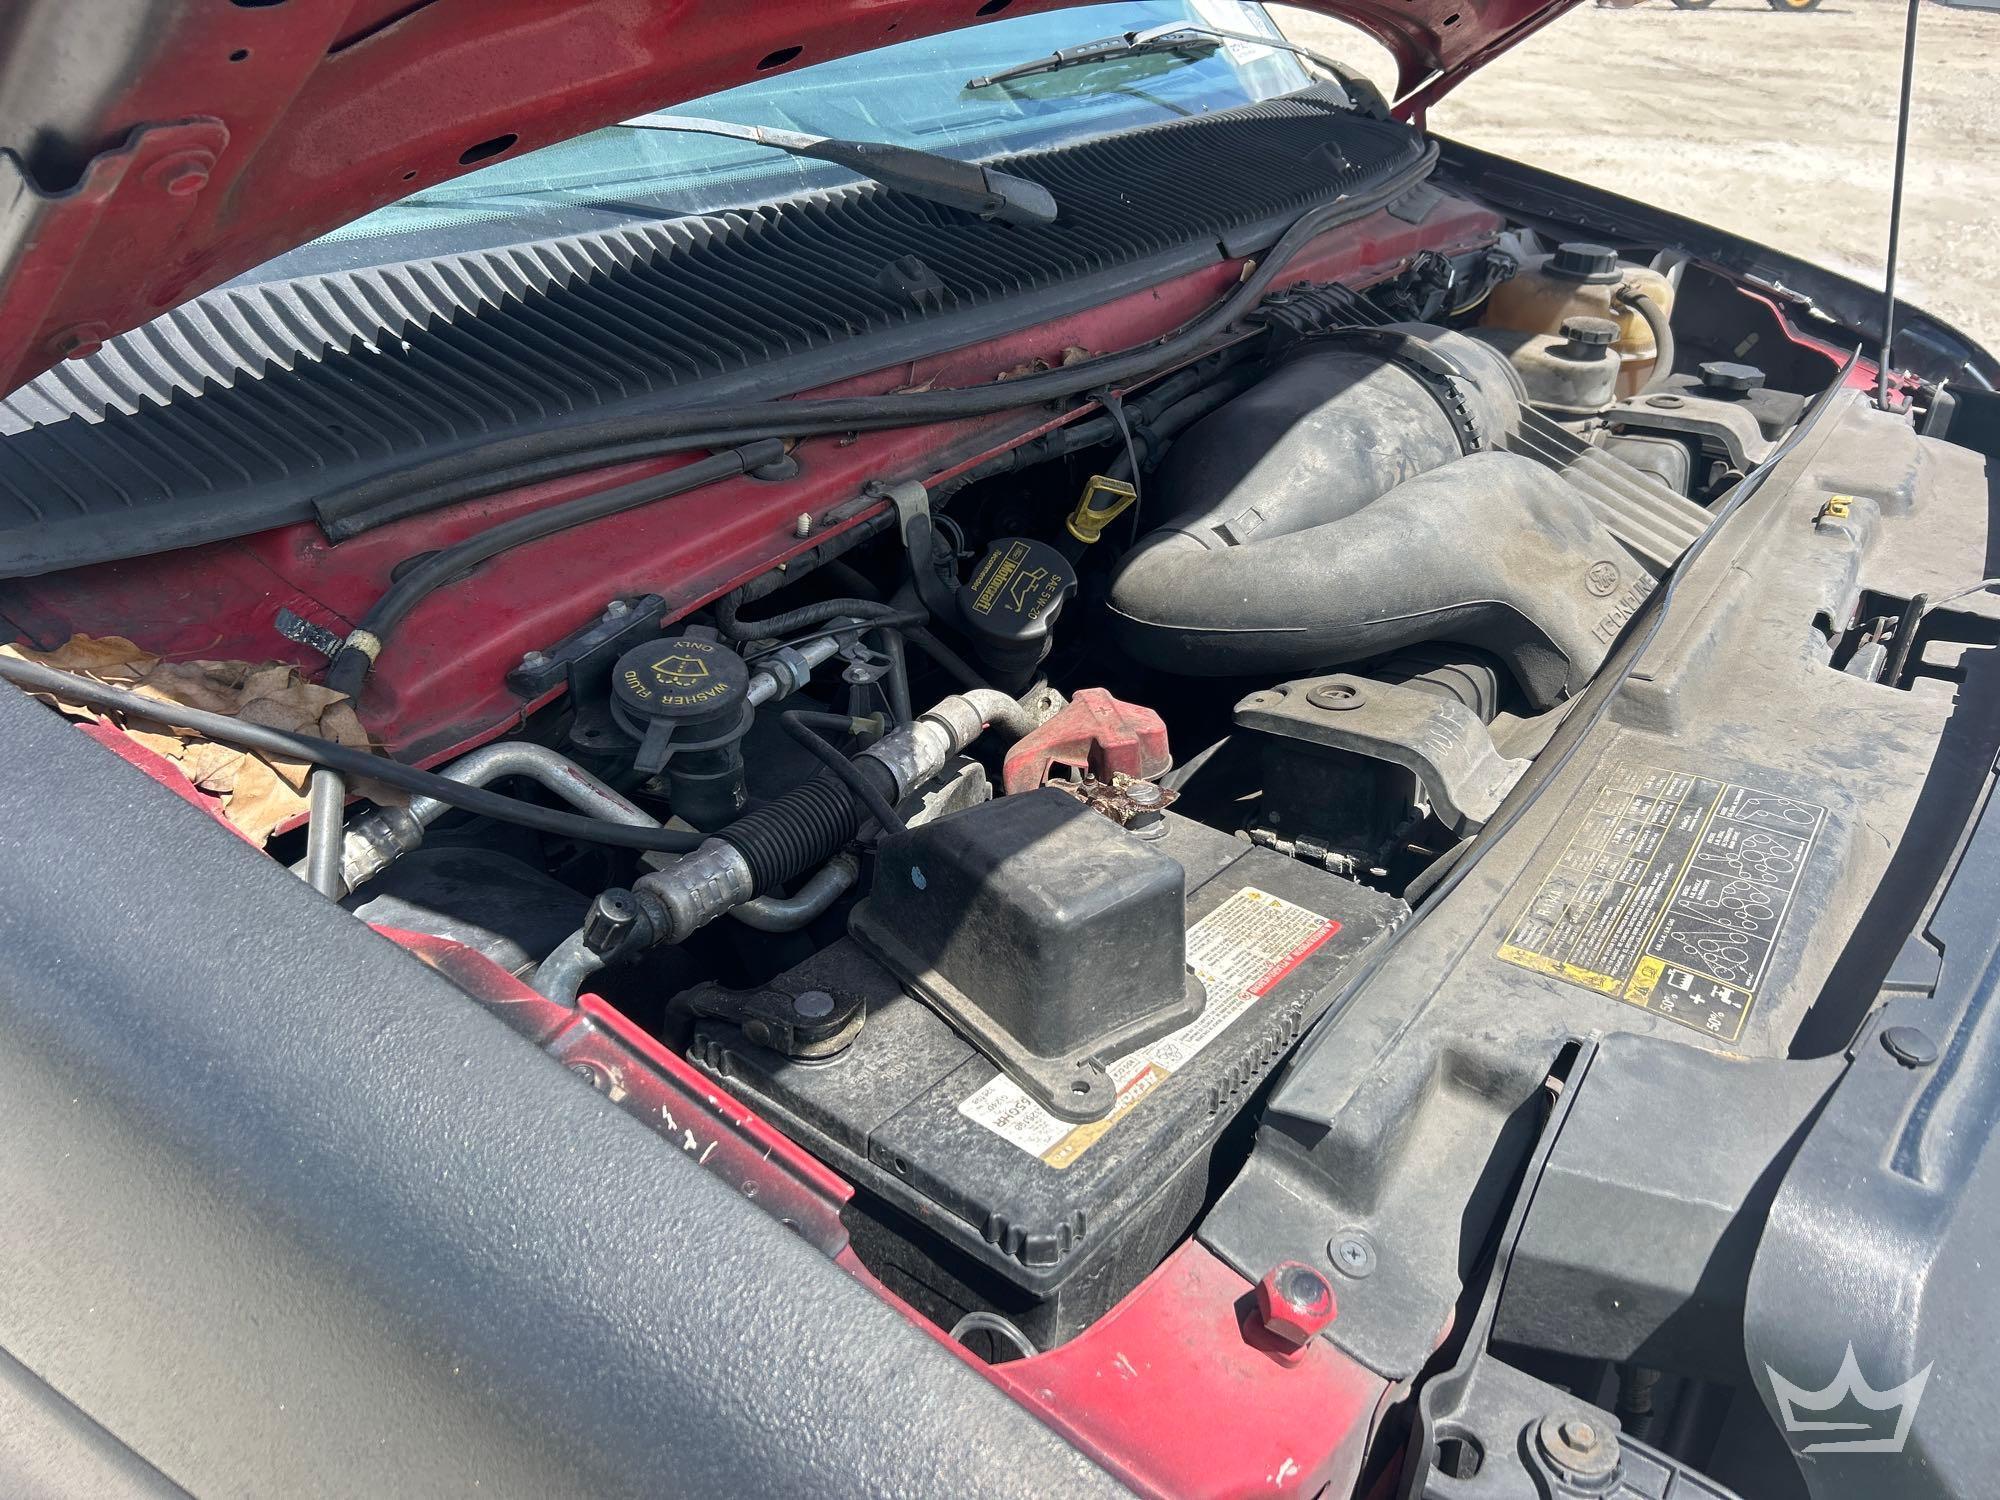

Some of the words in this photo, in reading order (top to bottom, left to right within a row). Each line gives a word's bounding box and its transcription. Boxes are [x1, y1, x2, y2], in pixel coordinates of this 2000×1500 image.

[971, 549, 1002, 591] Recommended
[976, 560, 1016, 610] Motorcraft
[1047, 575, 1061, 592] SAE
[1028, 592, 1051, 620] 5W-20
[1592, 574, 1655, 644] ECONOLINE
[673, 641, 713, 652] ONLY
[624, 670, 651, 699] FLUID
[662, 683, 728, 705] WASHER
[1659, 992, 1679, 1013] 50%
[1706, 1010, 1726, 1032] 50%
